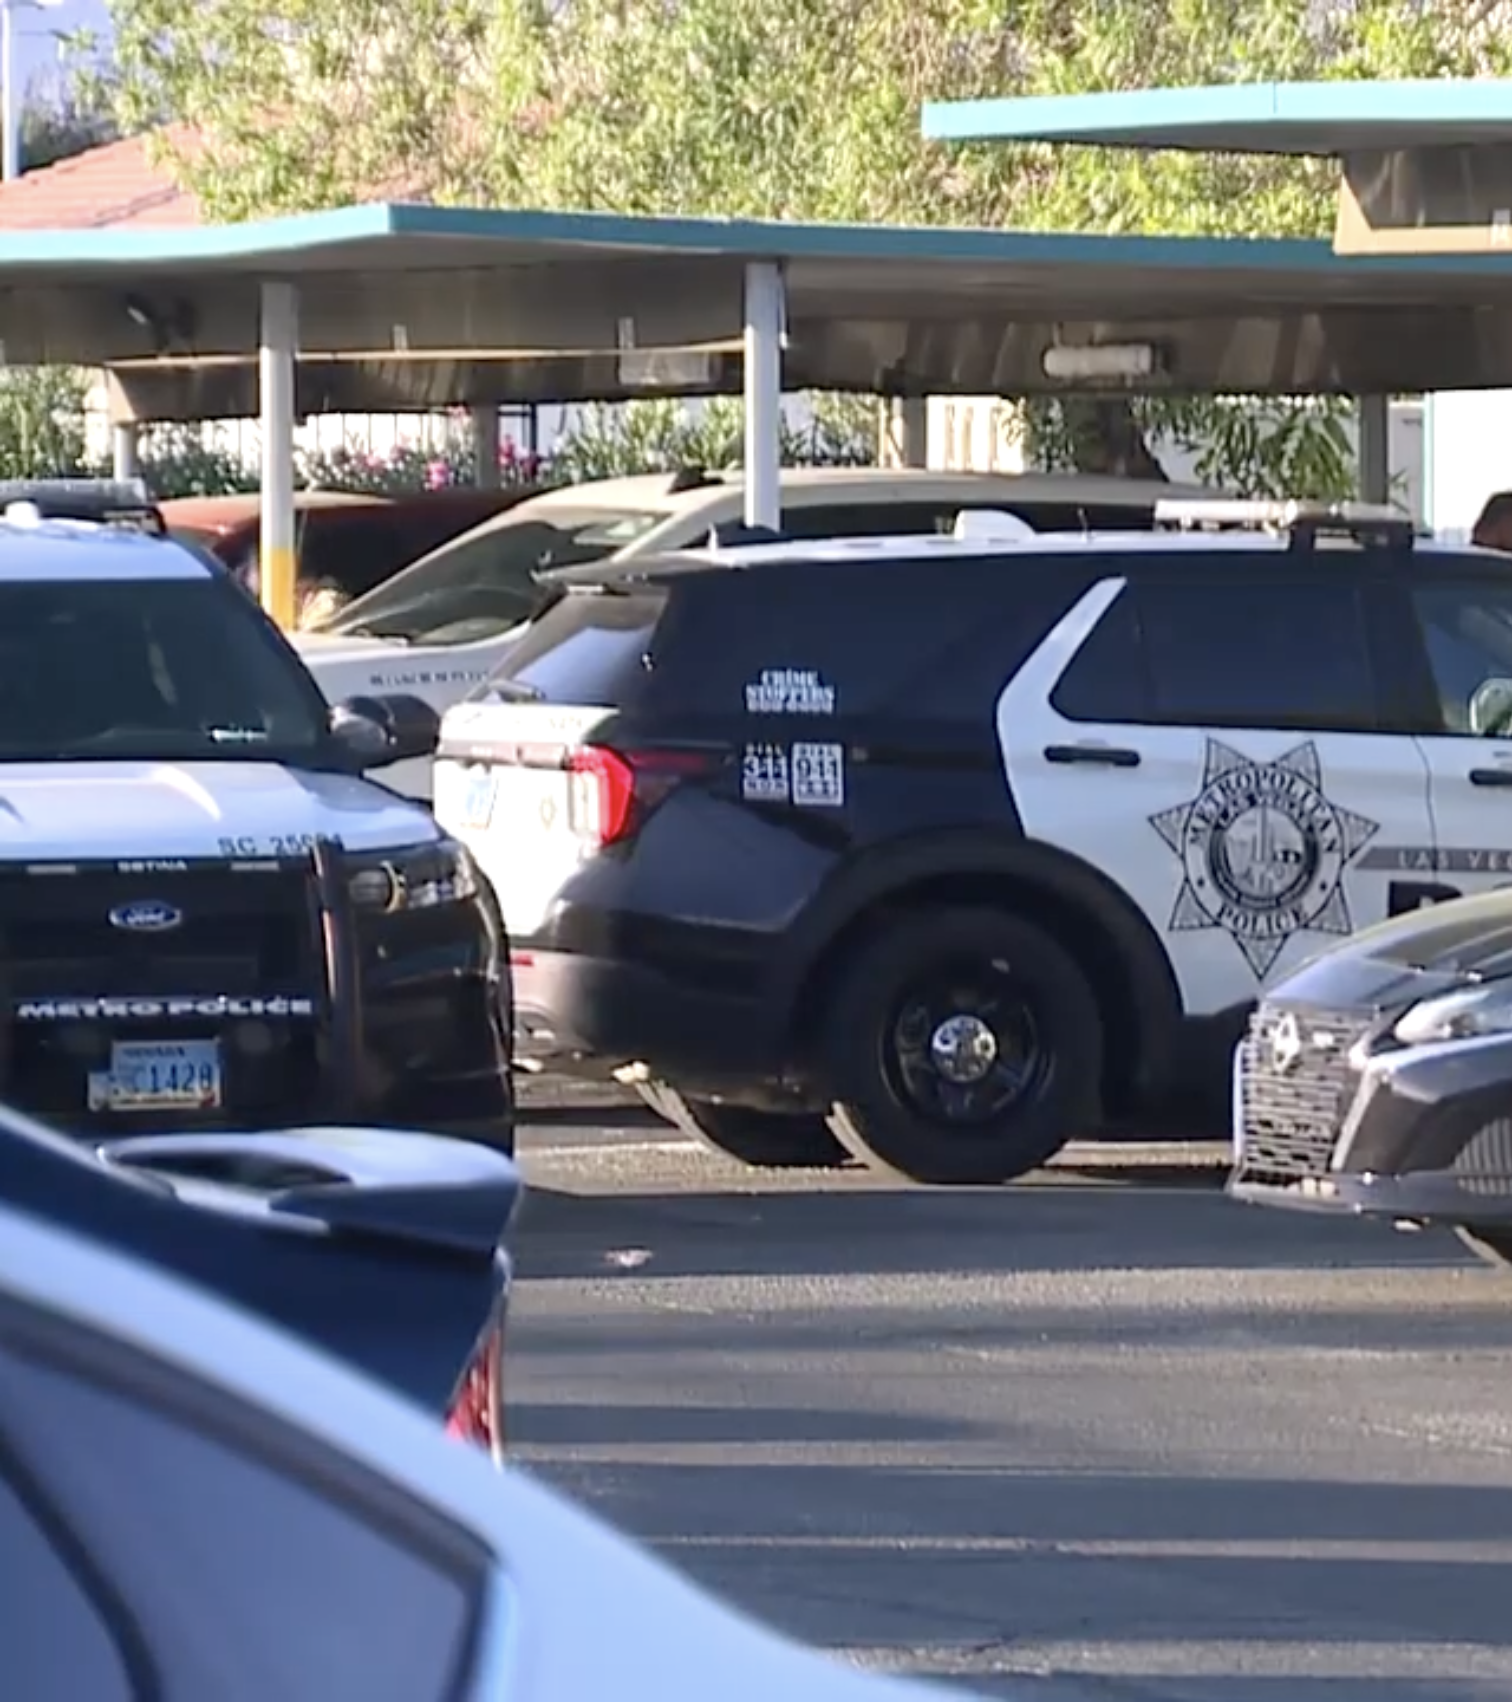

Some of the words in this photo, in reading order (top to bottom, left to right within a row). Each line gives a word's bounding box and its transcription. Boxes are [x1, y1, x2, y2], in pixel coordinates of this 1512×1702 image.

[761, 669, 819, 685] CRIME
[1188, 769, 1338, 852] METROPOLITAN
[217, 835, 257, 857] SC
[117, 860, 188, 872] SETINA
[1399, 852, 1449, 869] LAS
[1215, 902, 1308, 934] POLICE
[17, 1001, 161, 1017] METRO
[168, 999, 313, 1015] POLICE
